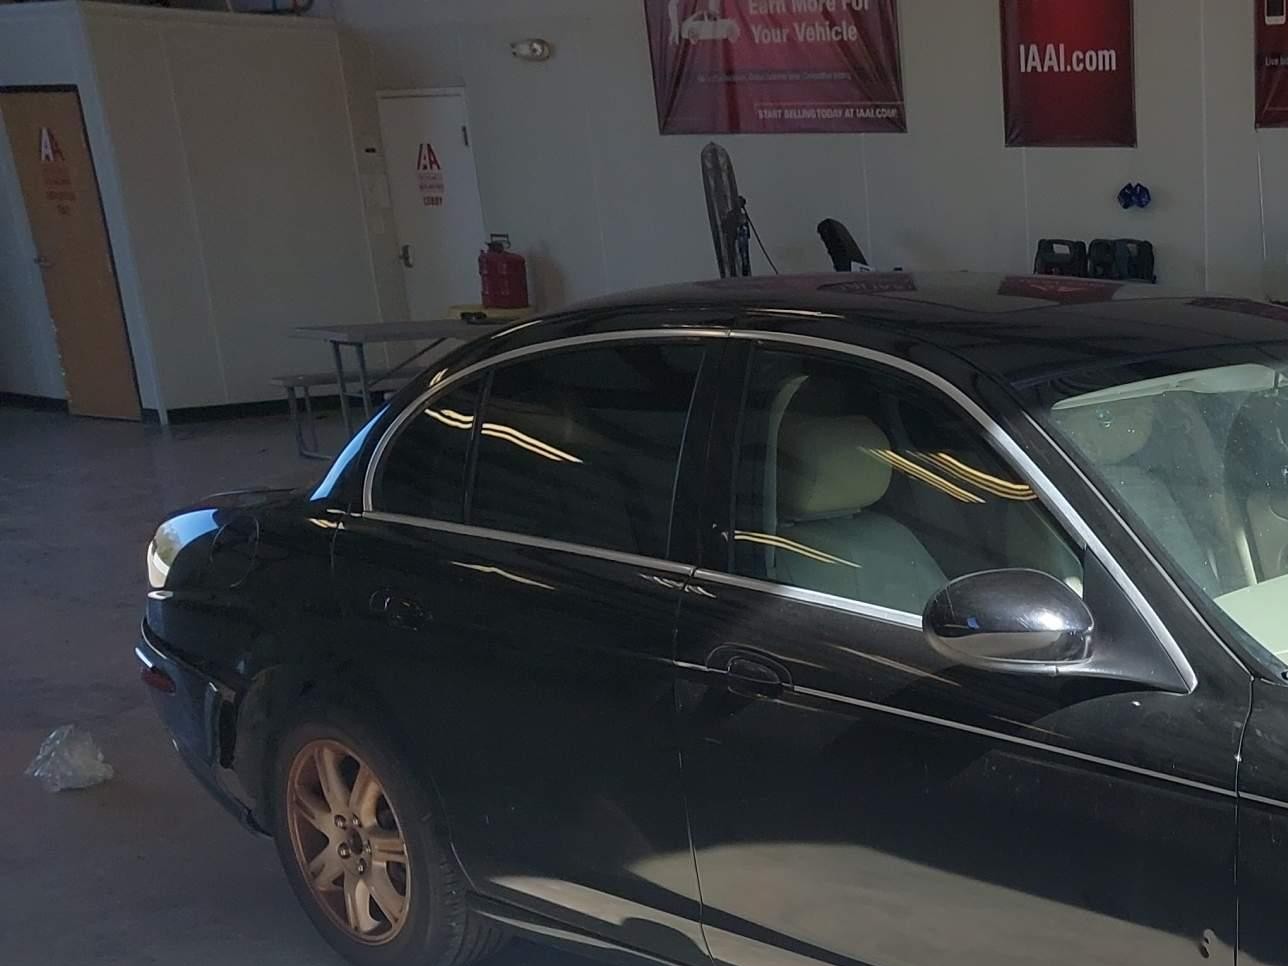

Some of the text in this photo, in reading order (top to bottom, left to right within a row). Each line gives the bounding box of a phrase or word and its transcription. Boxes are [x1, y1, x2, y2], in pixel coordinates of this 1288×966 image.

[751, 20, 857, 44] Your Vehicle
[1019, 43, 1117, 73] IAAI.com
